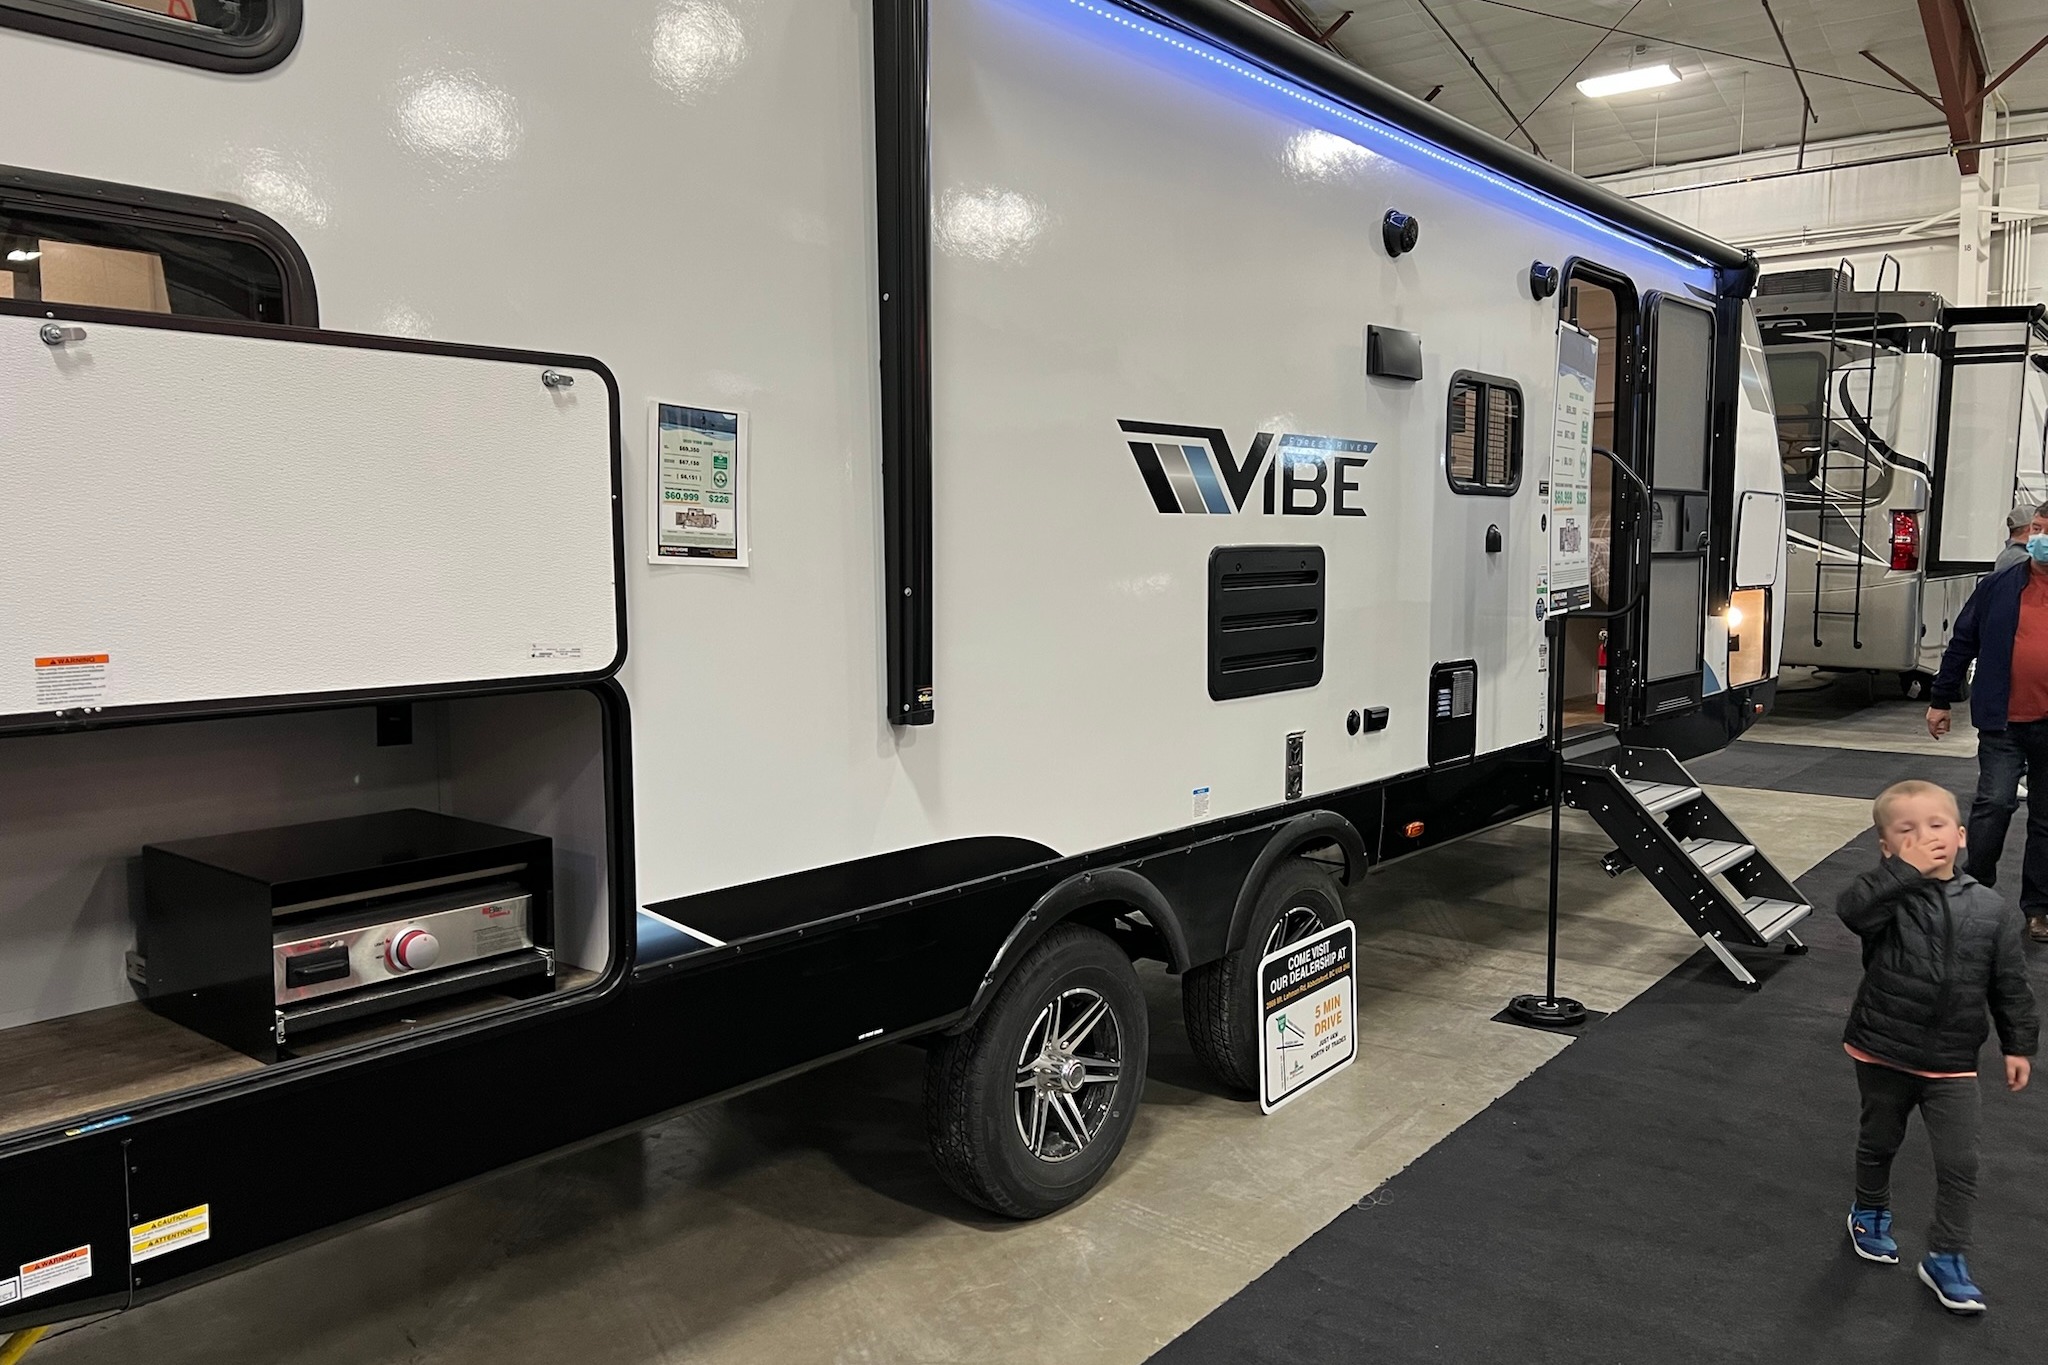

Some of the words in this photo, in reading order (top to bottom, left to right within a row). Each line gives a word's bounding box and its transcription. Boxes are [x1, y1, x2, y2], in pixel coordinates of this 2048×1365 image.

[1964, 244, 1972, 252] 18
[1335, 441, 1369, 452] RIVER
[1208, 428, 1369, 517] VIBE
[664, 491, 699, 501] $60,999
[708, 494, 729, 503] $226
[57, 657, 96, 665] WARNING
[1288, 948, 1311, 971] COME
[1311, 940, 1331, 960] VISIT
[1270, 974, 1289, 994] OUR
[1289, 952, 1337, 985] DEALERSHIP
[1337, 946, 1347, 962] AT
[1315, 1005, 1321, 1019] 5
[1323, 994, 1341, 1015] MIN
[1314, 1011, 1343, 1037] DRIVE
[1319, 1037, 1330, 1048] JUST
[1310, 1048, 1325, 1061] NORTH
[157, 1212, 189, 1228] CAUTION
[154, 1227, 193, 1244] ATTENTION
[41, 1252, 77, 1267] WARNING
